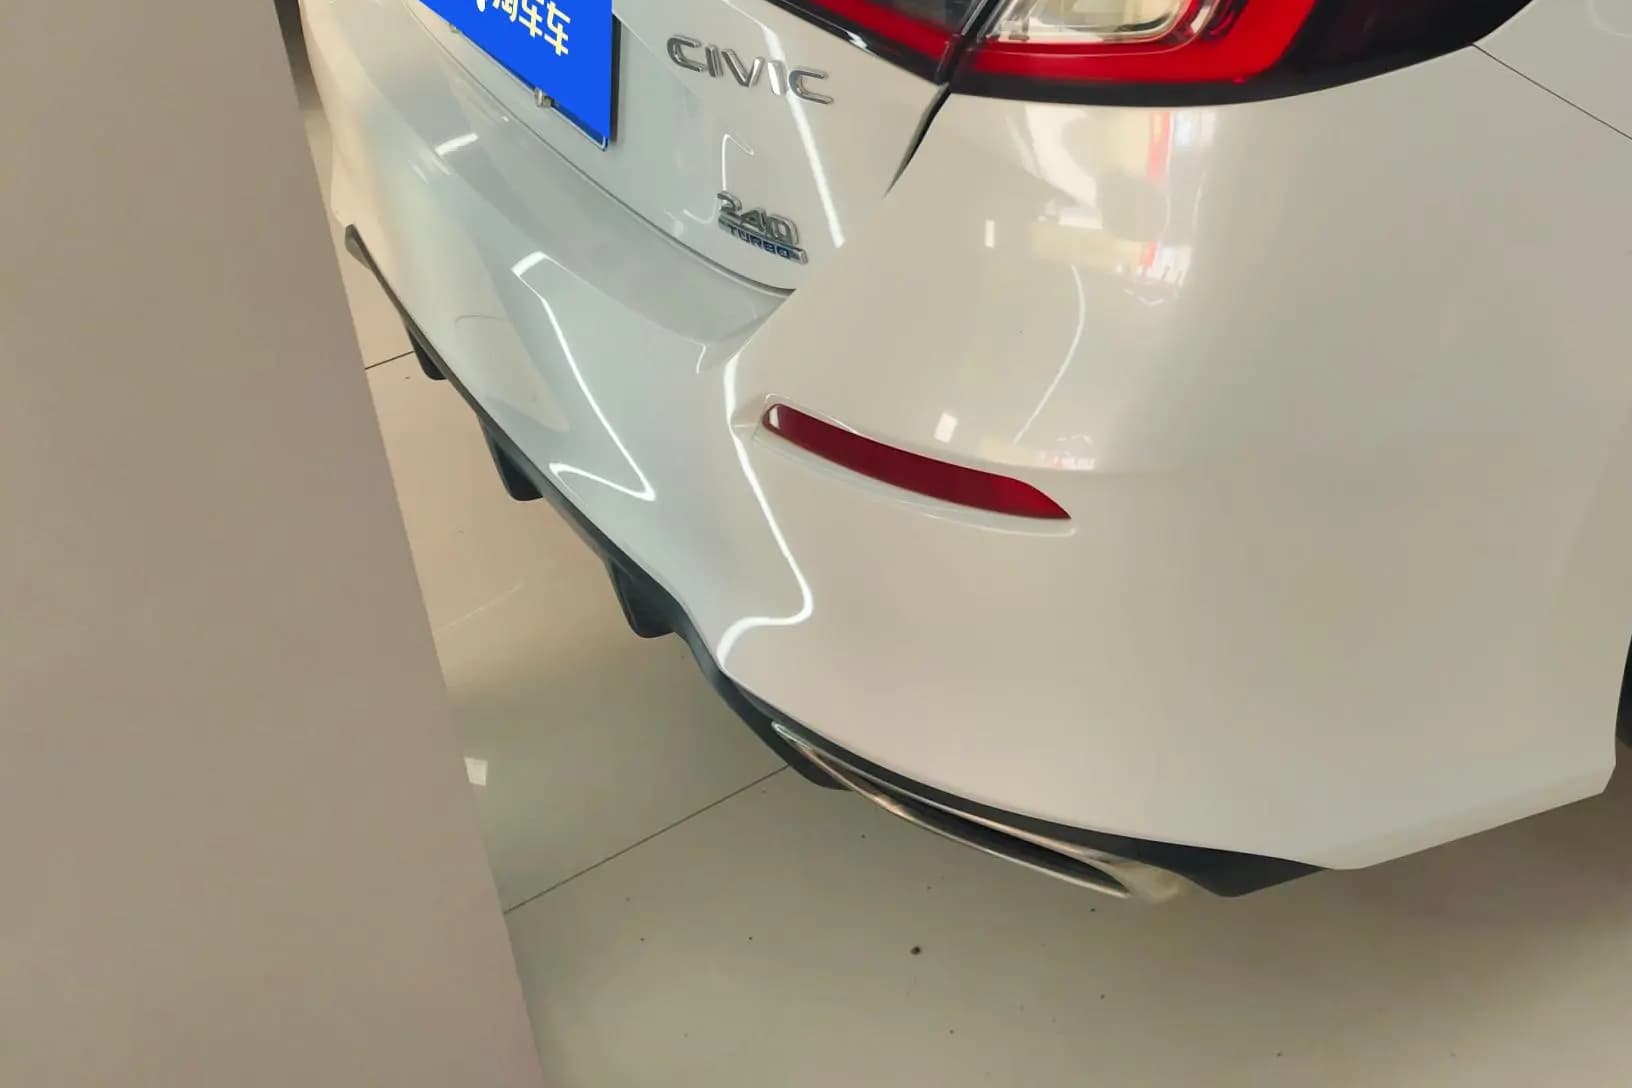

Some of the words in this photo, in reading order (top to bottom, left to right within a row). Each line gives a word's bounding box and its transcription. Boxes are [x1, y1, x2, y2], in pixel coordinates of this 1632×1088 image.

[666, 33, 834, 105] CIVIC
[716, 190, 800, 246] 240
[725, 225, 793, 262] TURBO
